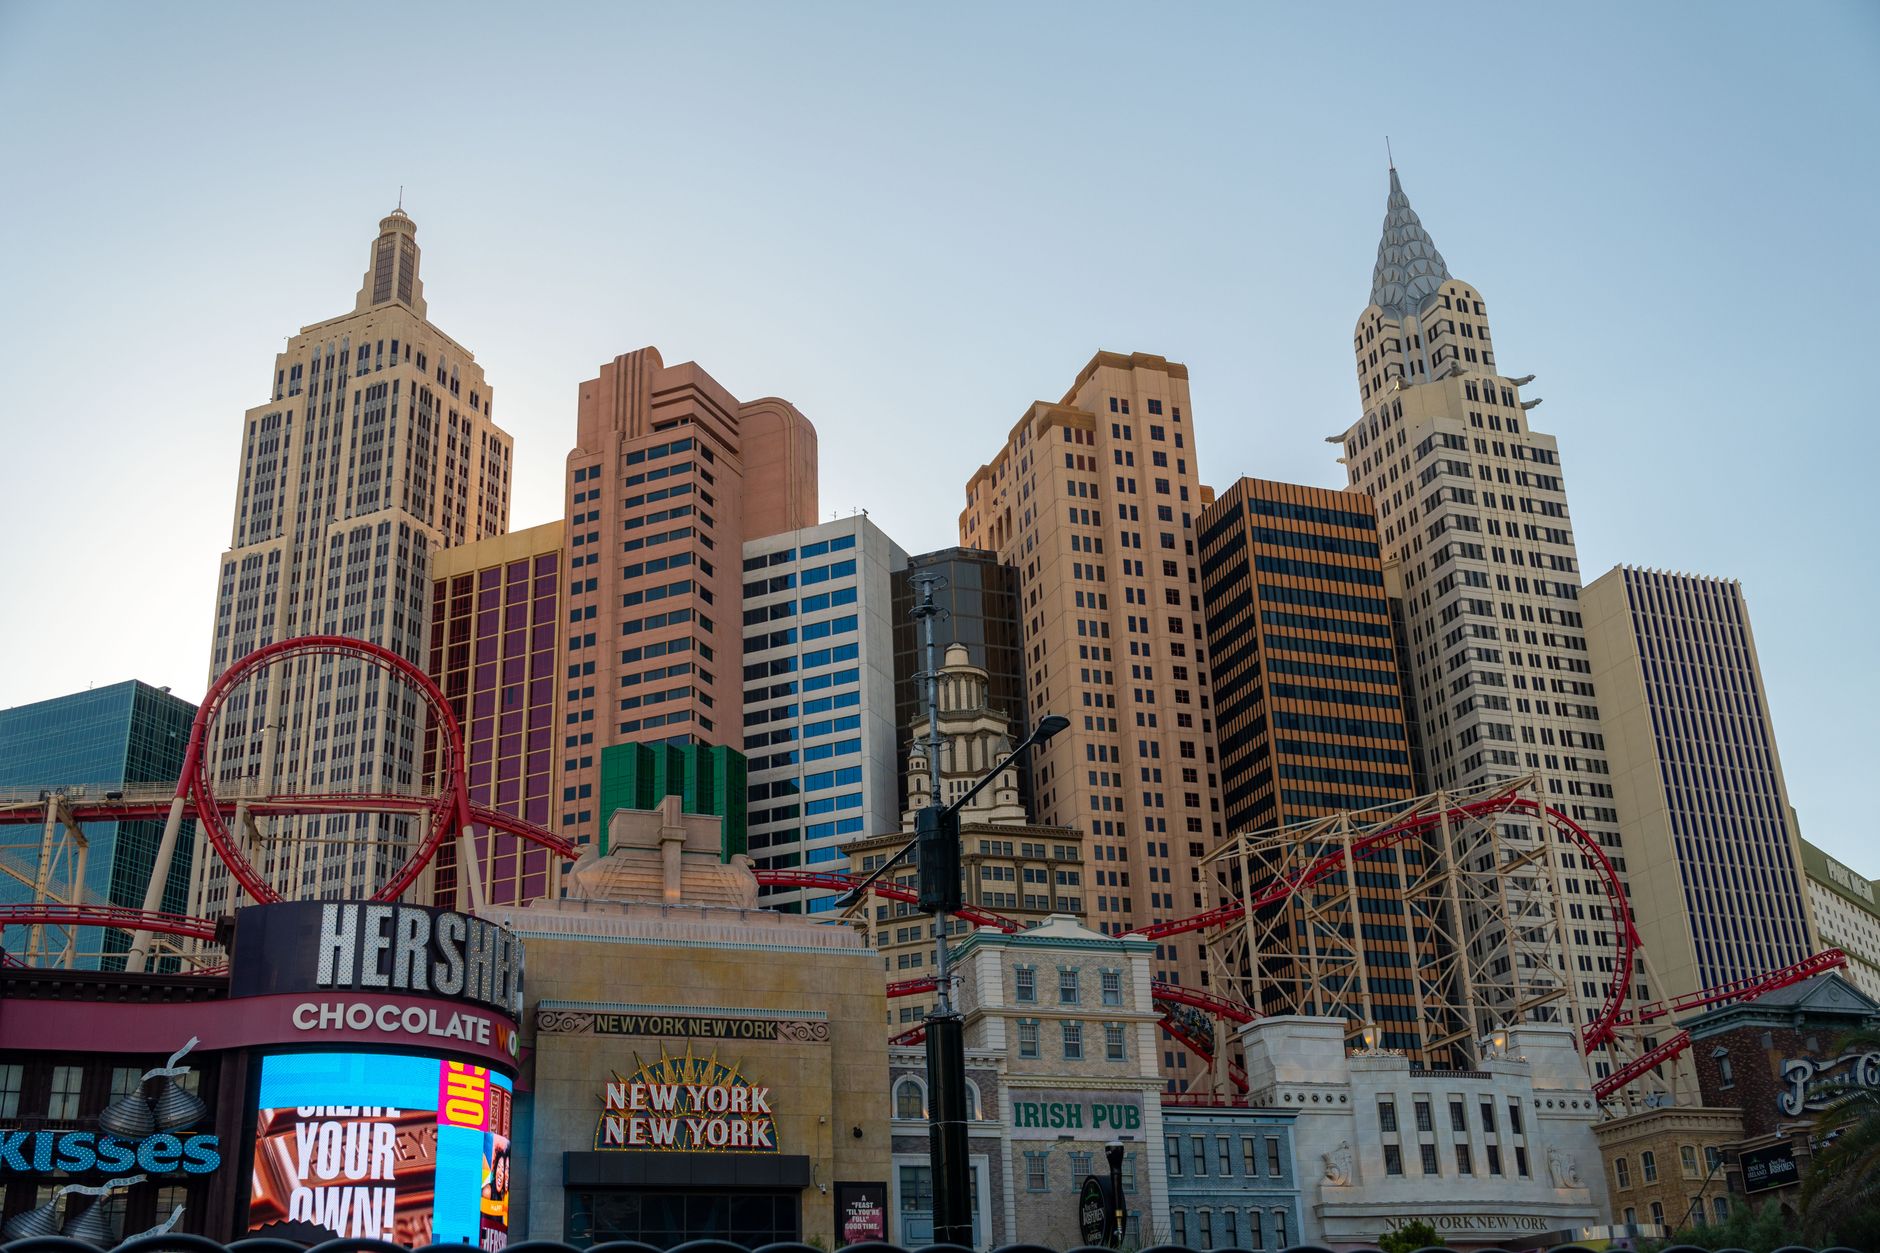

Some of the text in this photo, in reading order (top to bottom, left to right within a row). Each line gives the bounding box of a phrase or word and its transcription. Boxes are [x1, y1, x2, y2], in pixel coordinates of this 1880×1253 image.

[292, 1003, 491, 1045] CHOCOLATE
[596, 1015, 776, 1038] NEW YORK NEW YORK
[606, 1083, 772, 1114] NEW YORK
[1014, 1103, 1140, 1129] IRISH PUB
[605, 1117, 773, 1147] NEW YORK
[296, 1121, 396, 1180] YOUR
[1428, 1216, 1475, 1229] YORK
[1477, 1216, 1510, 1229] NEW
[1513, 1216, 1548, 1230] YORK
